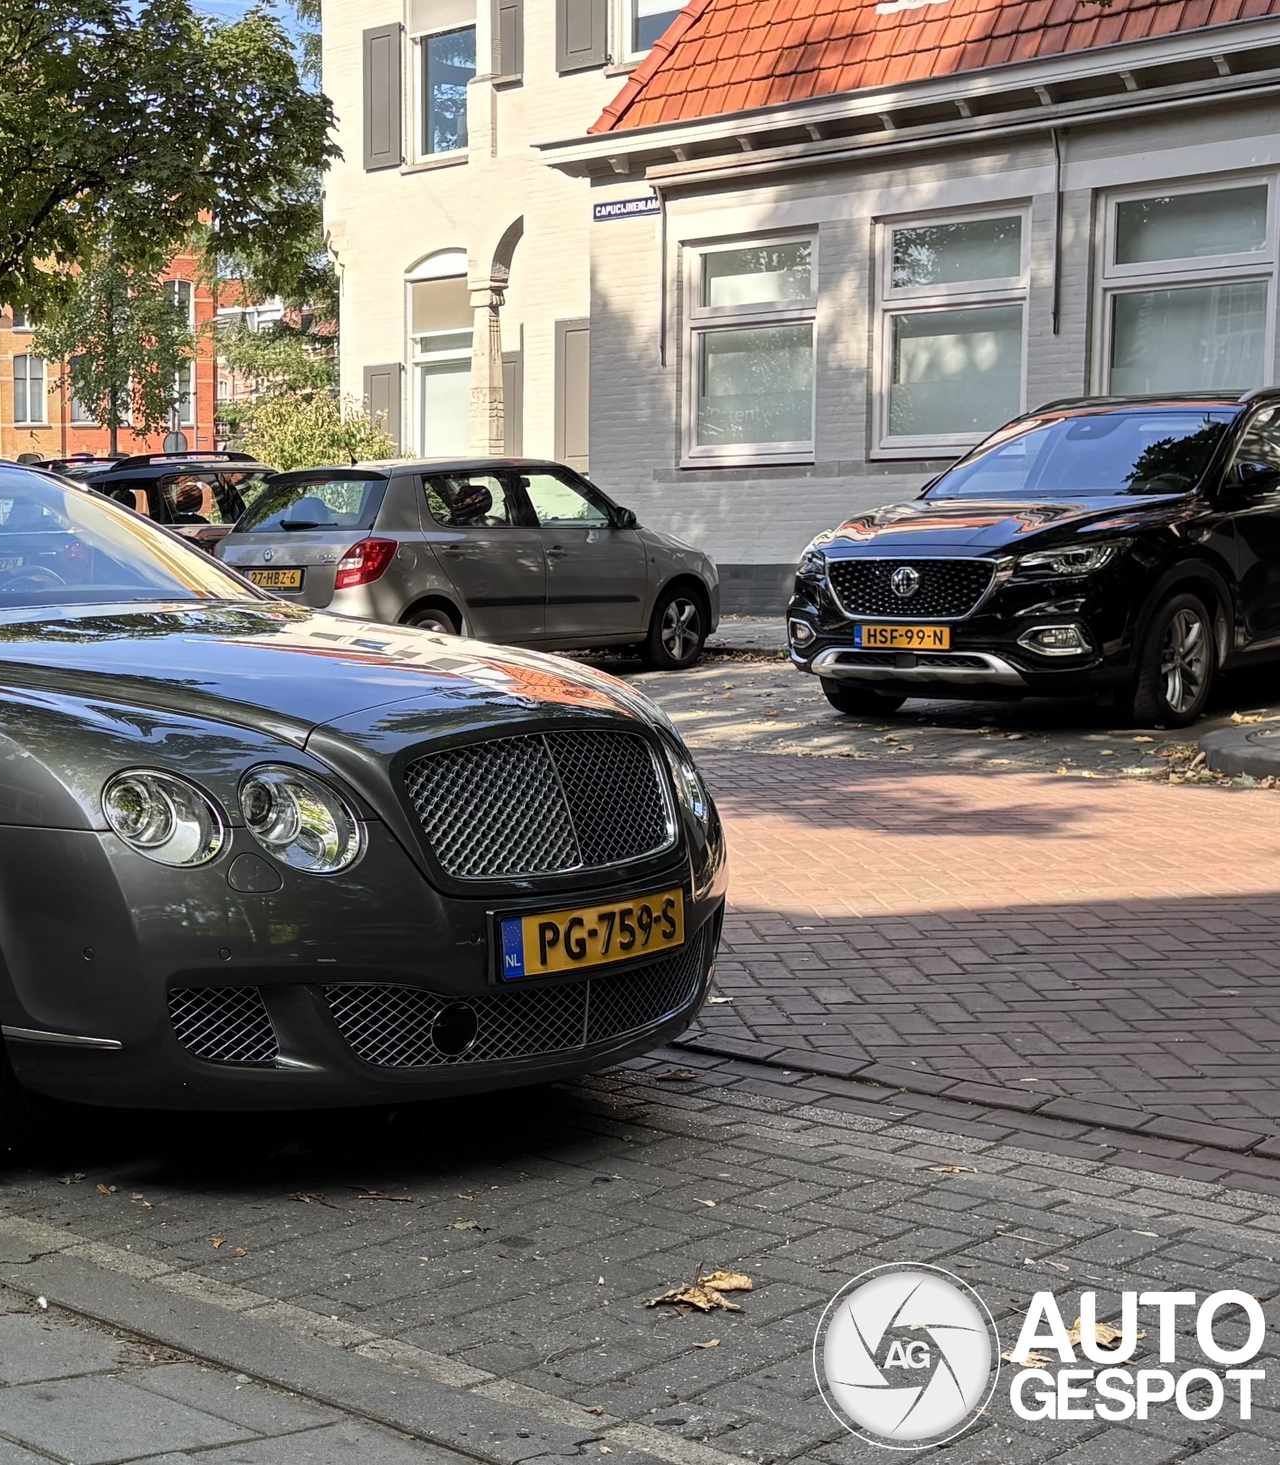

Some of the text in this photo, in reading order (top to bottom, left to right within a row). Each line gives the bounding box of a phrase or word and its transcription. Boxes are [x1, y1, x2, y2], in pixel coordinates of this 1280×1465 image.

[251, 572, 296, 585] 27-HBZ-6
[867, 628, 944, 646] HSF-99-N
[505, 898, 677, 968] NL PG-759-S
